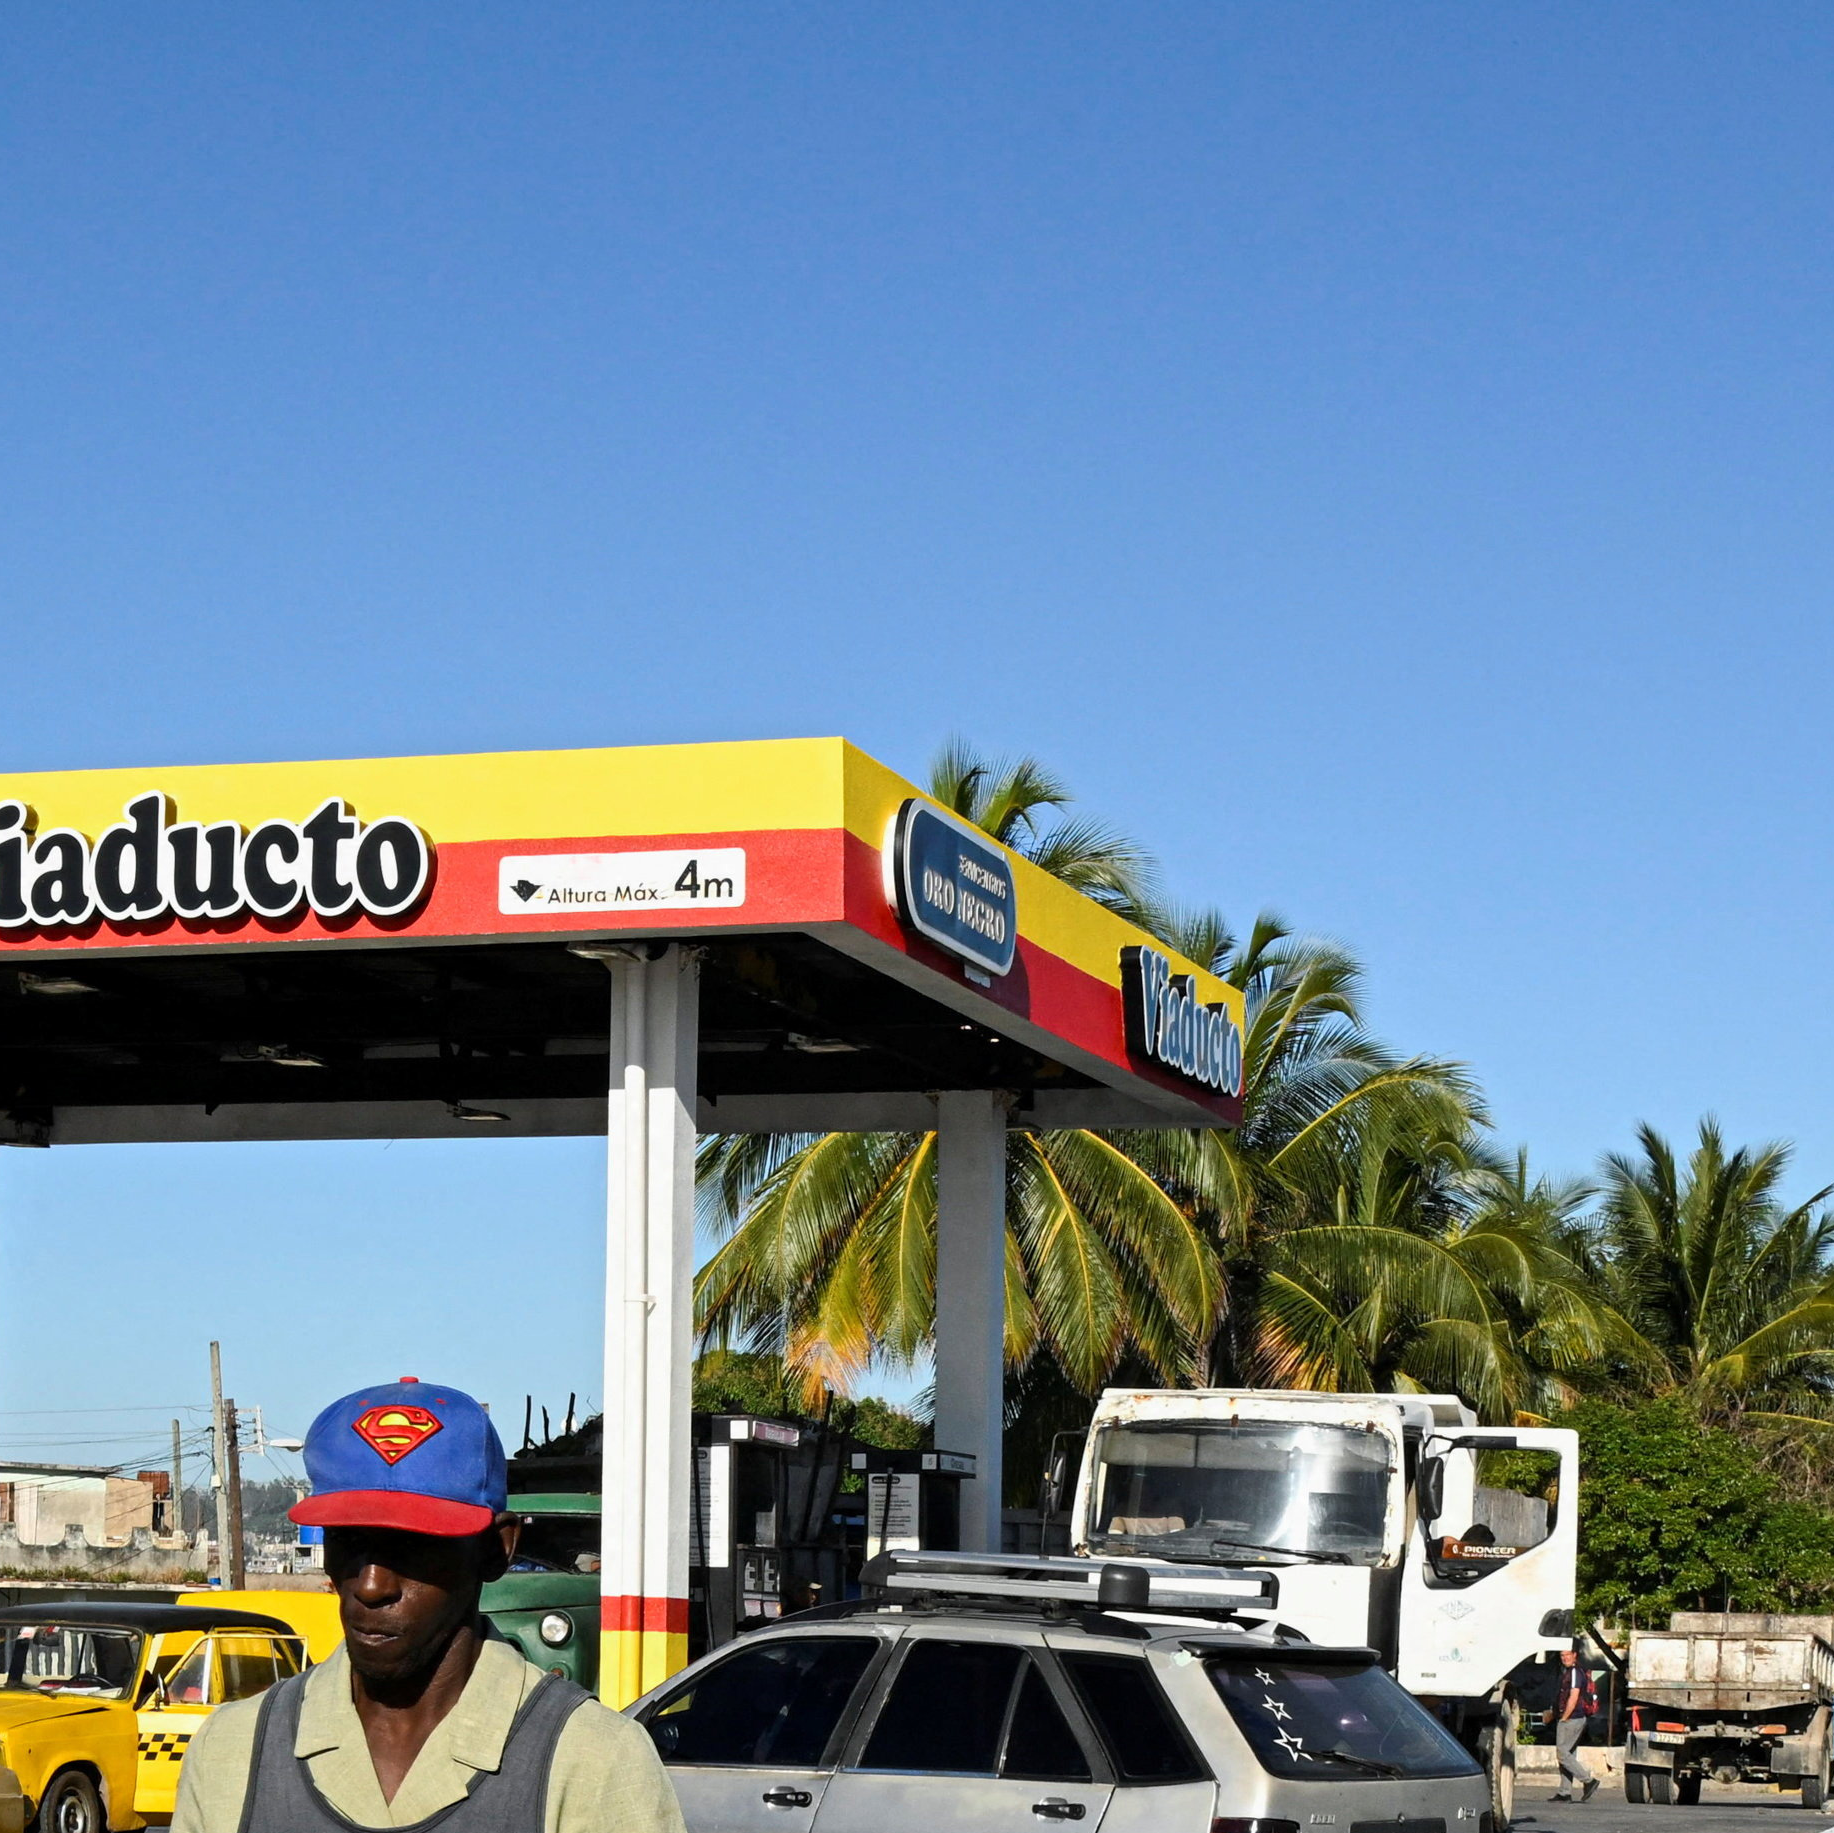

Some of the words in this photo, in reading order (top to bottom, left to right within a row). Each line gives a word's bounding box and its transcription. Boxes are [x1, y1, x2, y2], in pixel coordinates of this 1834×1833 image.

[548, 887, 607, 904] Altura
[674, 859, 734, 899] 4m
[922, 869, 955, 916] ORO
[957, 889, 1006, 945] NEGRO
[1139, 945, 1241, 1098] Viaducto
